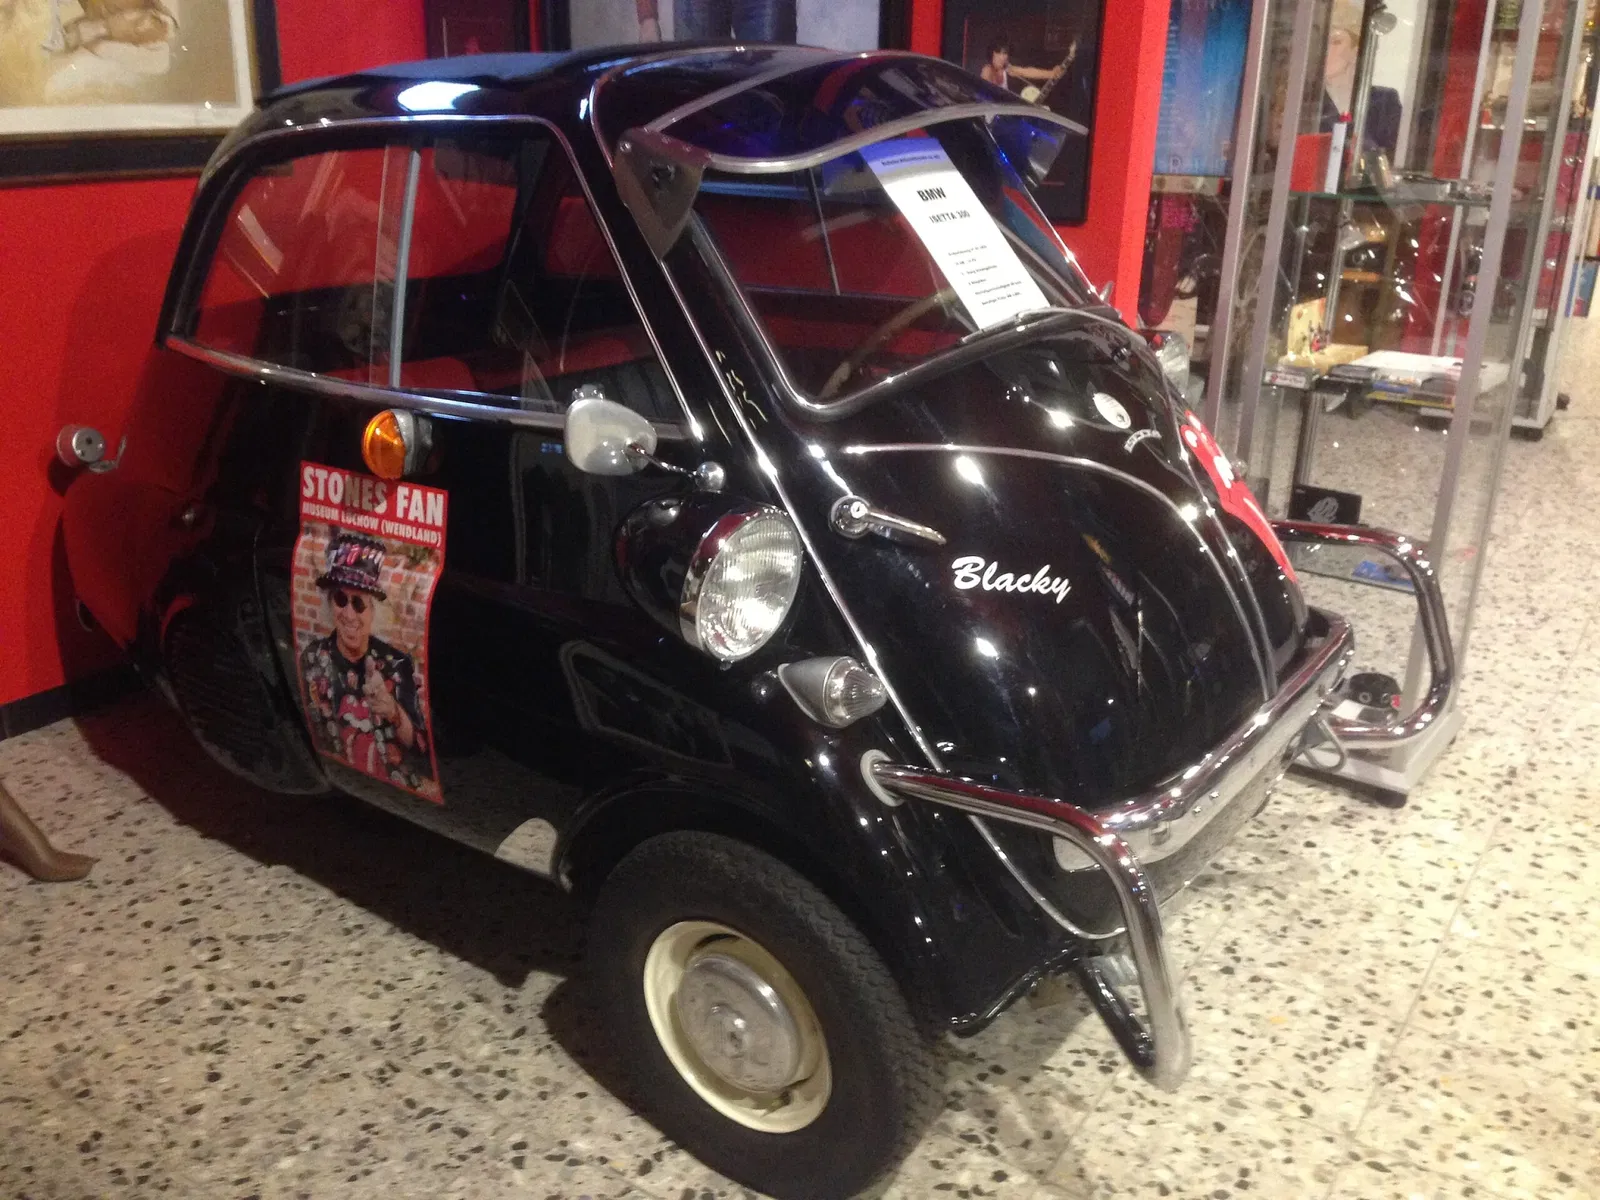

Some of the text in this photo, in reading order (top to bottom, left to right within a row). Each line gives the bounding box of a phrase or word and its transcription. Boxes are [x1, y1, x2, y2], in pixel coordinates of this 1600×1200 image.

[916, 187, 947, 202] BMW
[929, 211, 957, 224] ISETTA
[302, 465, 445, 528] STONES FAN
[302, 501, 339, 522] MUSEUM
[381, 519, 442, 547] (WENDLAND)
[951, 555, 1072, 604] Blacky
